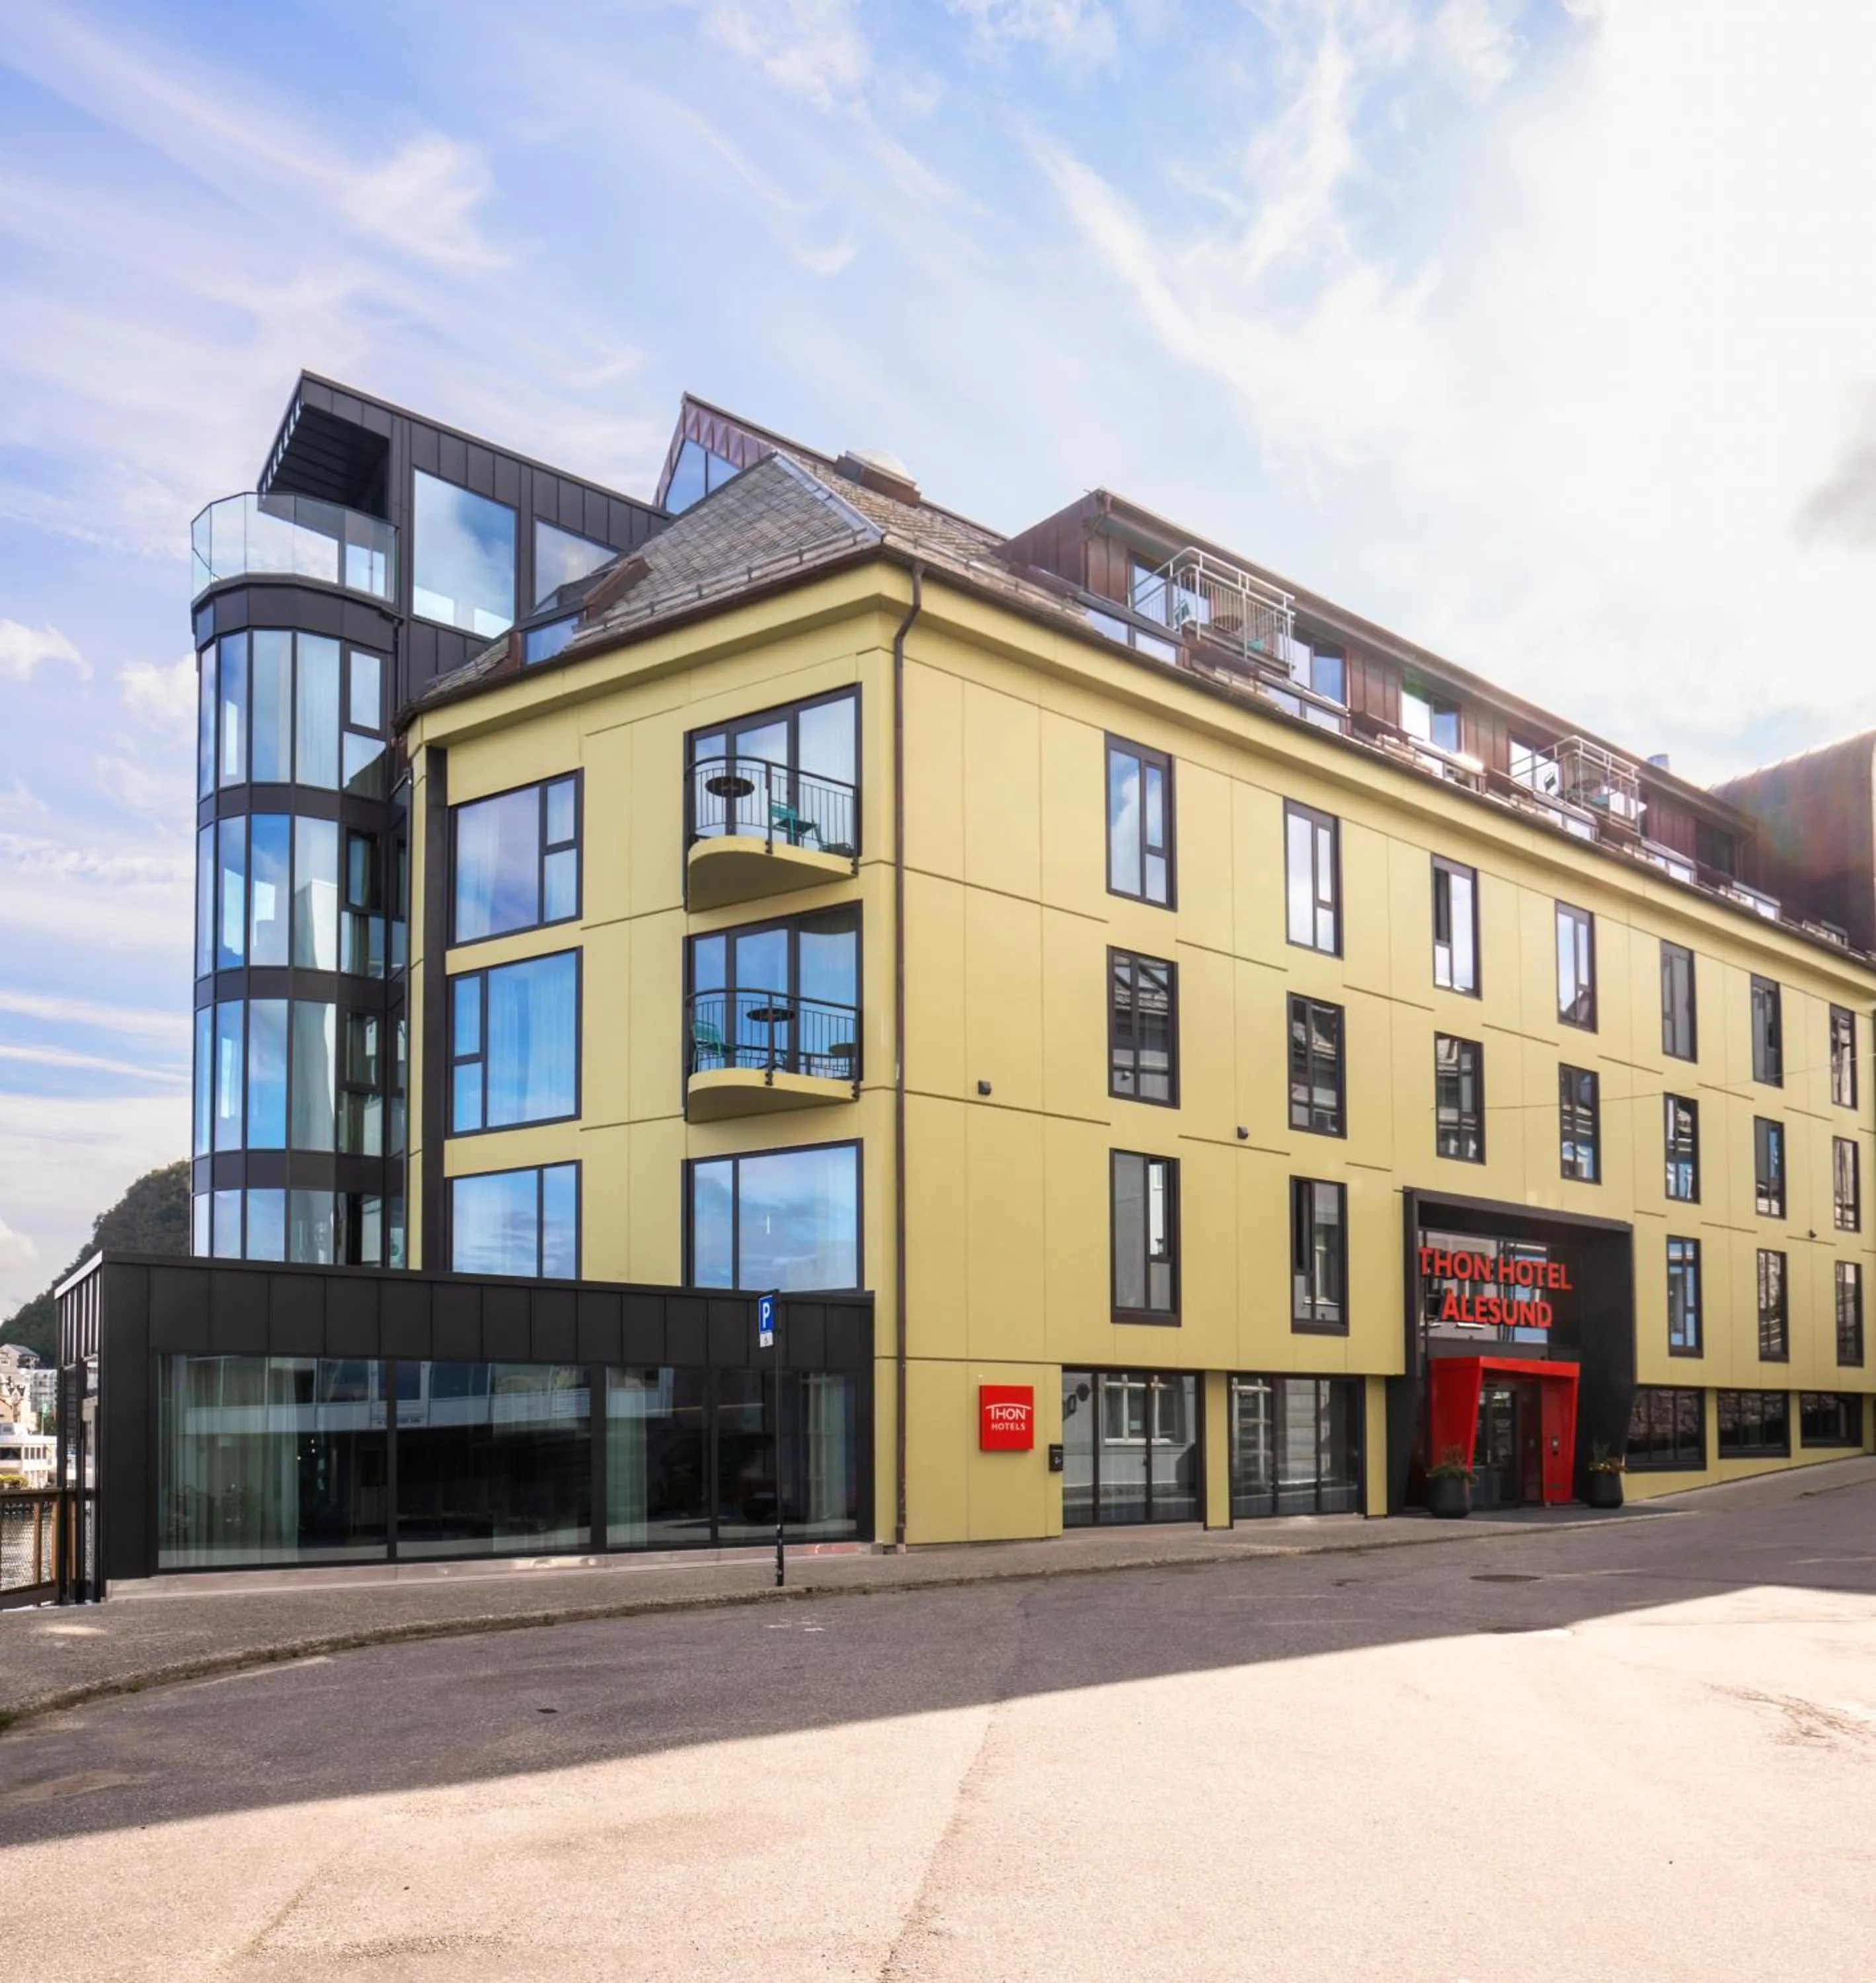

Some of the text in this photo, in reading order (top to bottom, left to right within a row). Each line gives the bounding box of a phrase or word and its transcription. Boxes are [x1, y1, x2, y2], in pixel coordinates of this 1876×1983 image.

[1419, 1247, 1573, 1290] THON HOTEL
[762, 1302, 770, 1329] P
[986, 1403, 1031, 1420] THON
[992, 1422, 1026, 1430] HOTELS
